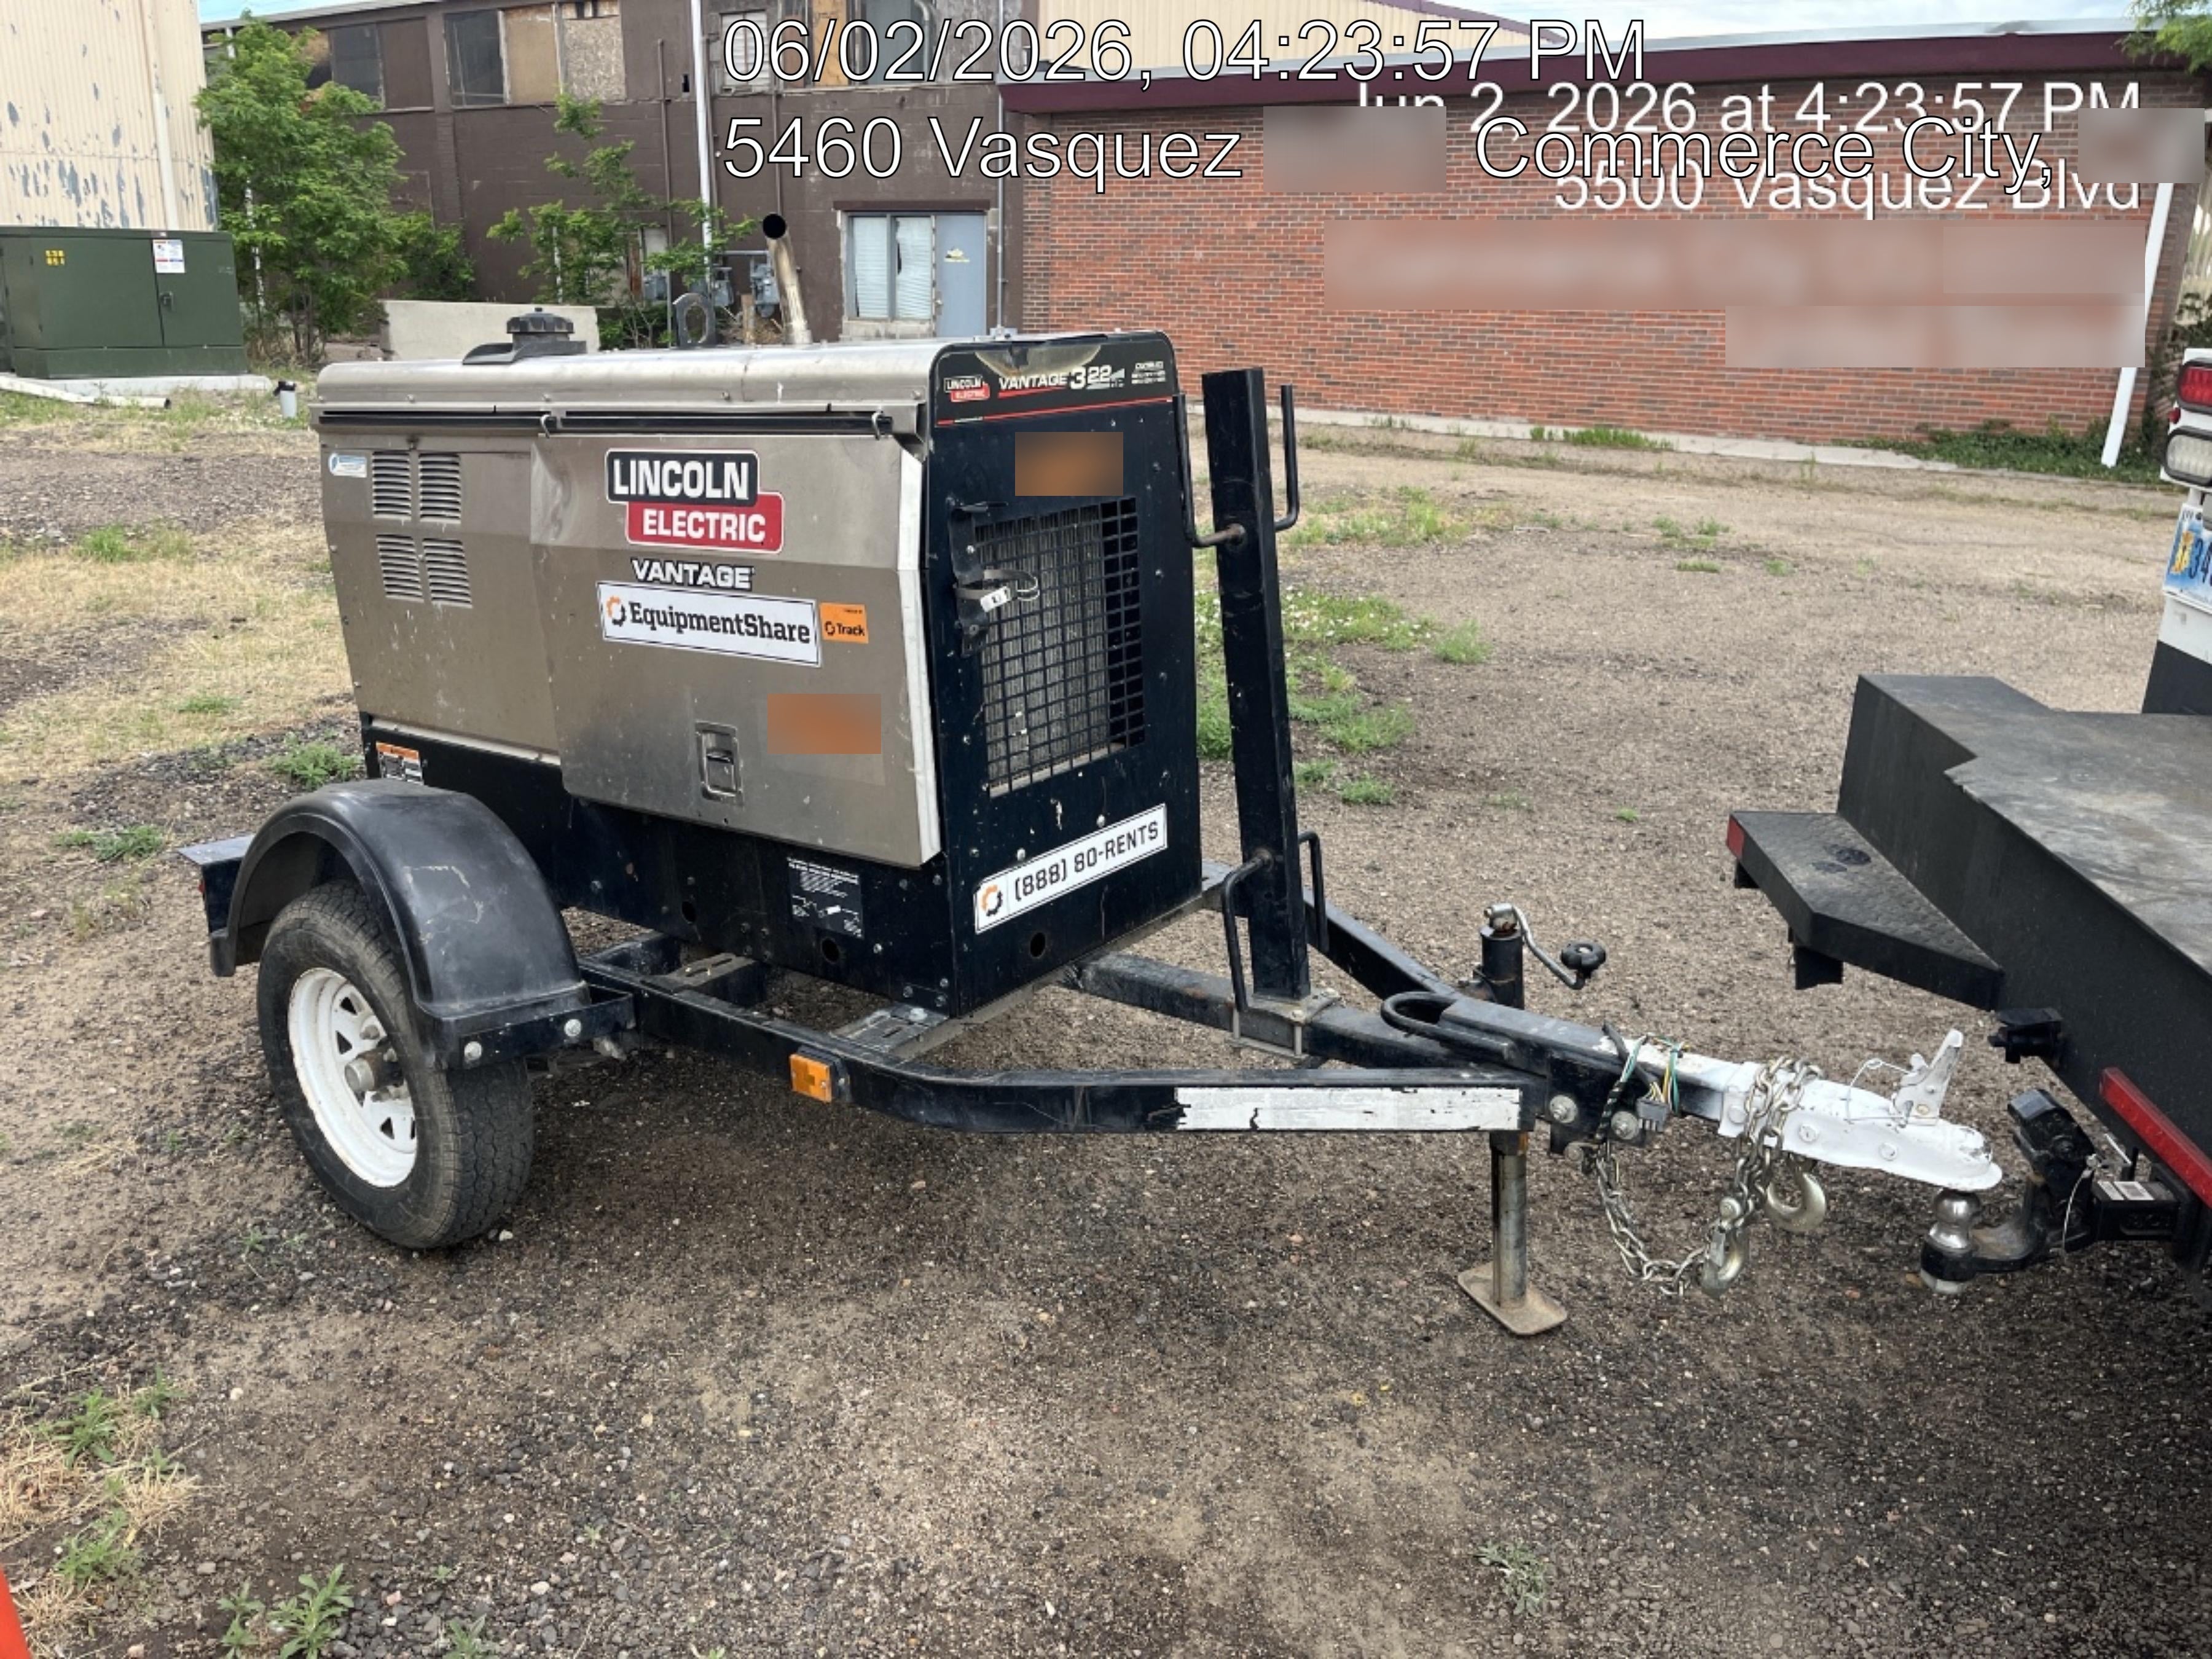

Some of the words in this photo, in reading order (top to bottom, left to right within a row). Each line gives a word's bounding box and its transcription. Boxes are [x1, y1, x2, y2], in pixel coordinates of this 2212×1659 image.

[998, 373, 1069, 390] VANTAGE
[613, 460, 749, 500] LINCOLN
[643, 508, 766, 543] ELECTRIC
[632, 559, 752, 590] VANTAGE
[628, 601, 810, 644] EquipmentShare
[836, 622, 865, 637] Track
[1014, 858, 1068, 902] (888)
[1073, 820, 1159, 873] 80-RENTS
